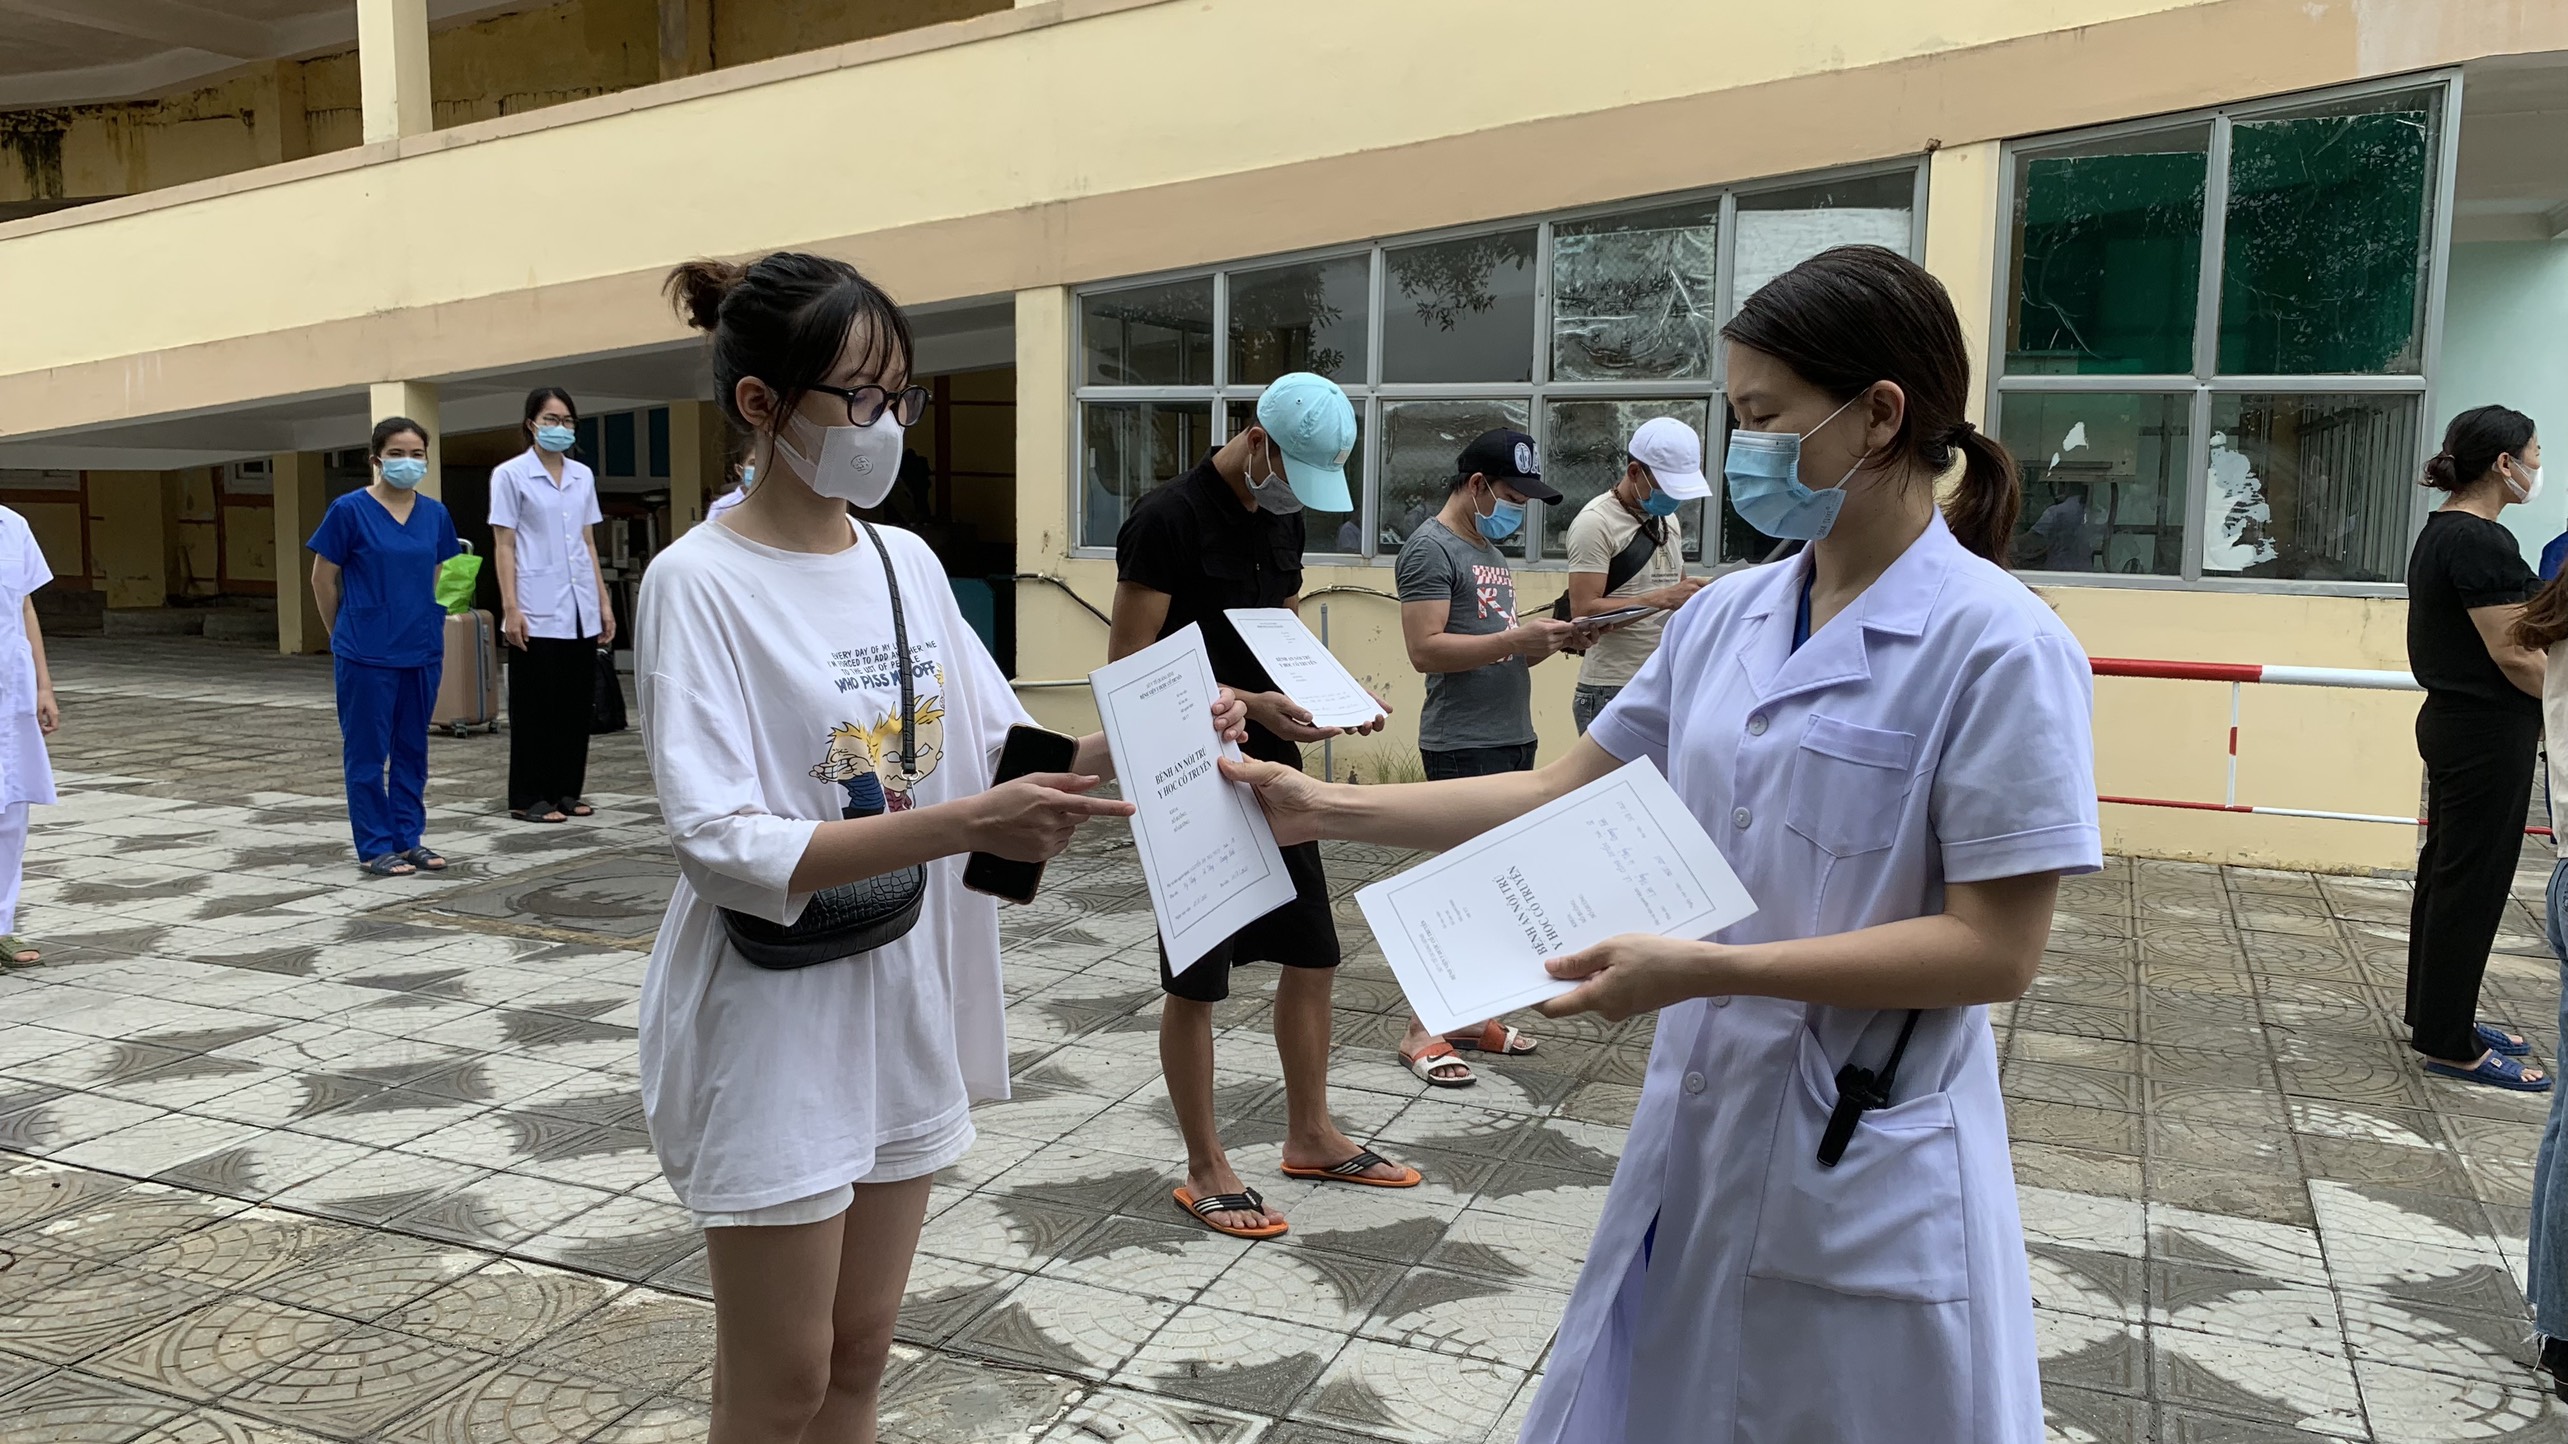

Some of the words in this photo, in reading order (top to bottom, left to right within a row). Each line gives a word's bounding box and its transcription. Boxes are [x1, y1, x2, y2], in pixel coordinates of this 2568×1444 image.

[855, 647, 868, 657] DAY
[871, 645, 879, 654] OF
[882, 643, 891, 652] MY
[862, 656, 872, 665] TO
[874, 653, 889, 663] ADD
[878, 662, 888, 672] OF
[890, 655, 921, 669] PELE
[834, 676, 860, 694] WHO
[860, 673, 890, 690] PISS
[912, 660, 935, 678] OFF
[1155, 767, 1174, 785] BỆNH
[1174, 760, 1184, 773] ÁN
[1157, 790, 1163, 799] Y
[1163, 780, 1177, 797] HỌC
[1492, 875, 1511, 895] TRÚ
[1507, 865, 1535, 904] TRUYỀN
[1505, 893, 1522, 913] NỘI
[1525, 902, 1544, 917] CỔ
[1518, 912, 1529, 926] ÁN
[1538, 918, 1560, 941] HỌC
[1525, 926, 1548, 956] BỆNH
[1552, 942, 1563, 951] Y
